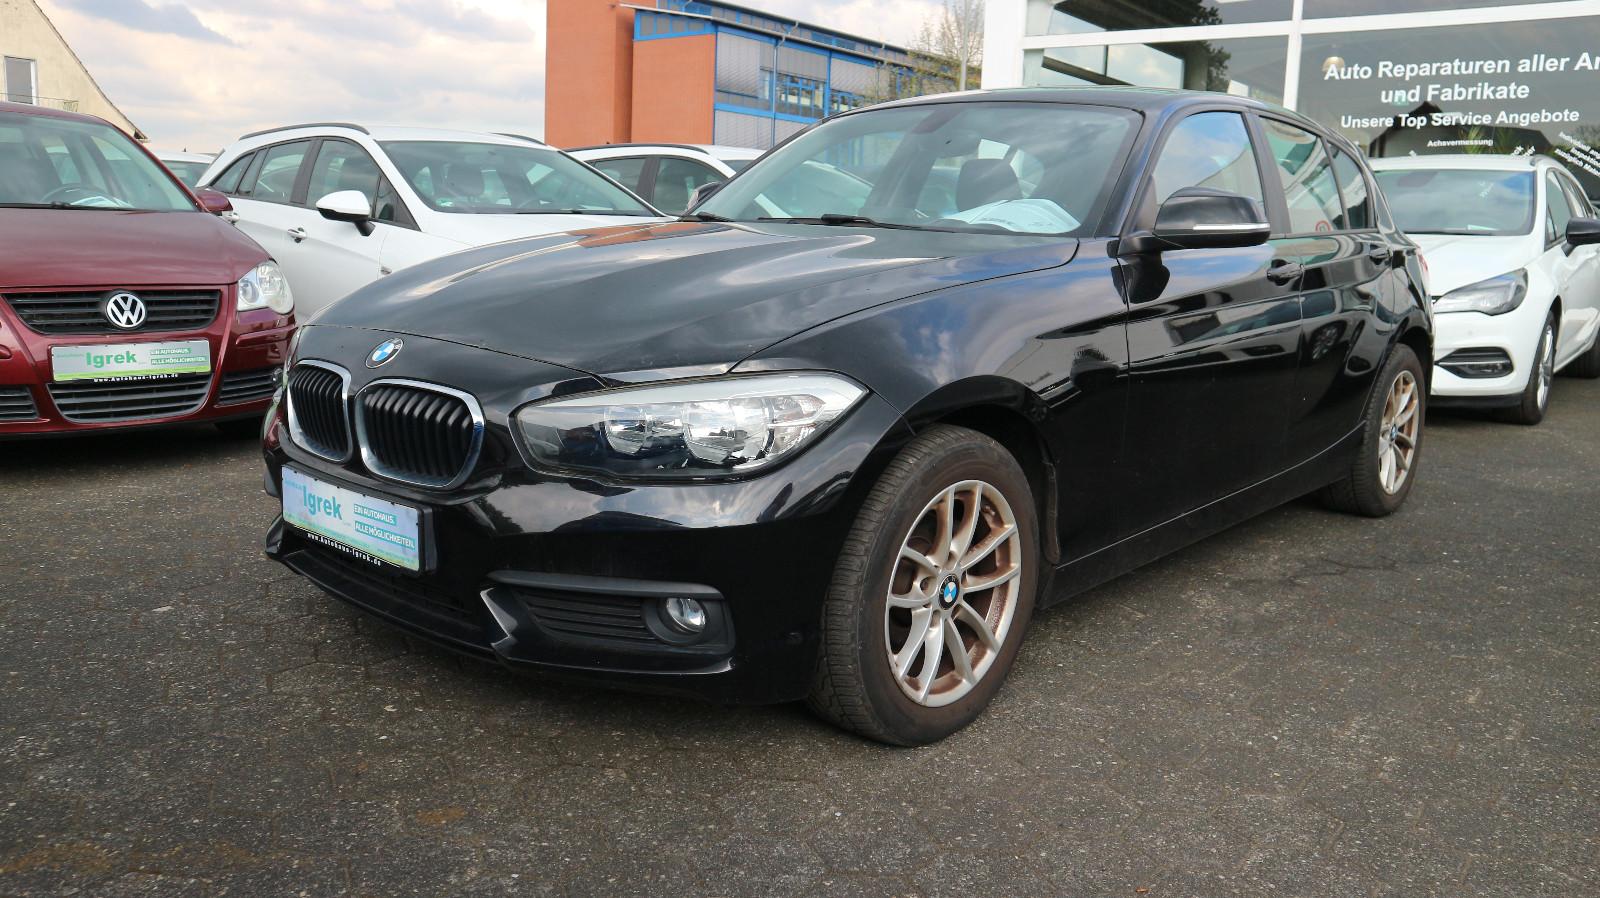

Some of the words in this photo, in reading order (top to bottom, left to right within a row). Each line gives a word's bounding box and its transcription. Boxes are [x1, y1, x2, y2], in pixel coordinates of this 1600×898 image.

[1324, 63, 1372, 80] Auto
[1378, 57, 1510, 81] Reparaturen
[1517, 54, 1570, 72] aller
[1381, 85, 1421, 103] und
[1427, 82, 1530, 102] Fabrikate
[1340, 115, 1394, 128] Unsere
[1399, 113, 1427, 129] Top
[1431, 111, 1492, 127] Service
[1495, 108, 1580, 126] Angebote
[1427, 138, 1494, 147] Achsvermessung
[86, 350, 137, 368] Igrek
[302, 486, 343, 520] Igrek
